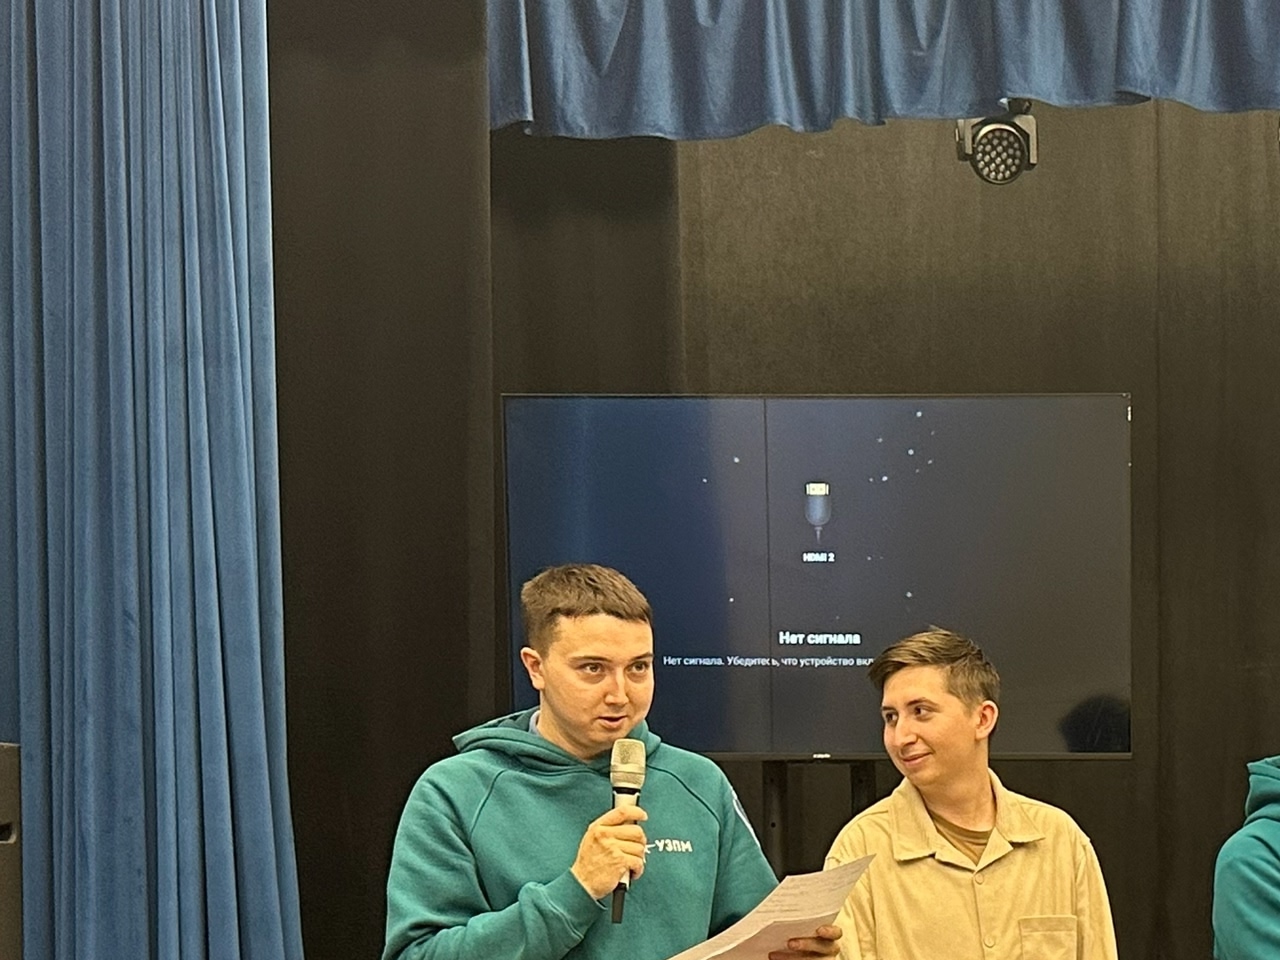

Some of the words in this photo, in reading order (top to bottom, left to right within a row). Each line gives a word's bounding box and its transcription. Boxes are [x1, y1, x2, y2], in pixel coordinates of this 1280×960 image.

[802, 551, 828, 562] HDMI
[828, 551, 836, 562] 2
[779, 630, 806, 645] Нет
[806, 632, 862, 645] сигнала
[662, 655, 682, 666] Нет
[781, 657, 798, 666] что
[799, 655, 855, 668] устройство
[654, 839, 693, 853] УЗПМ
